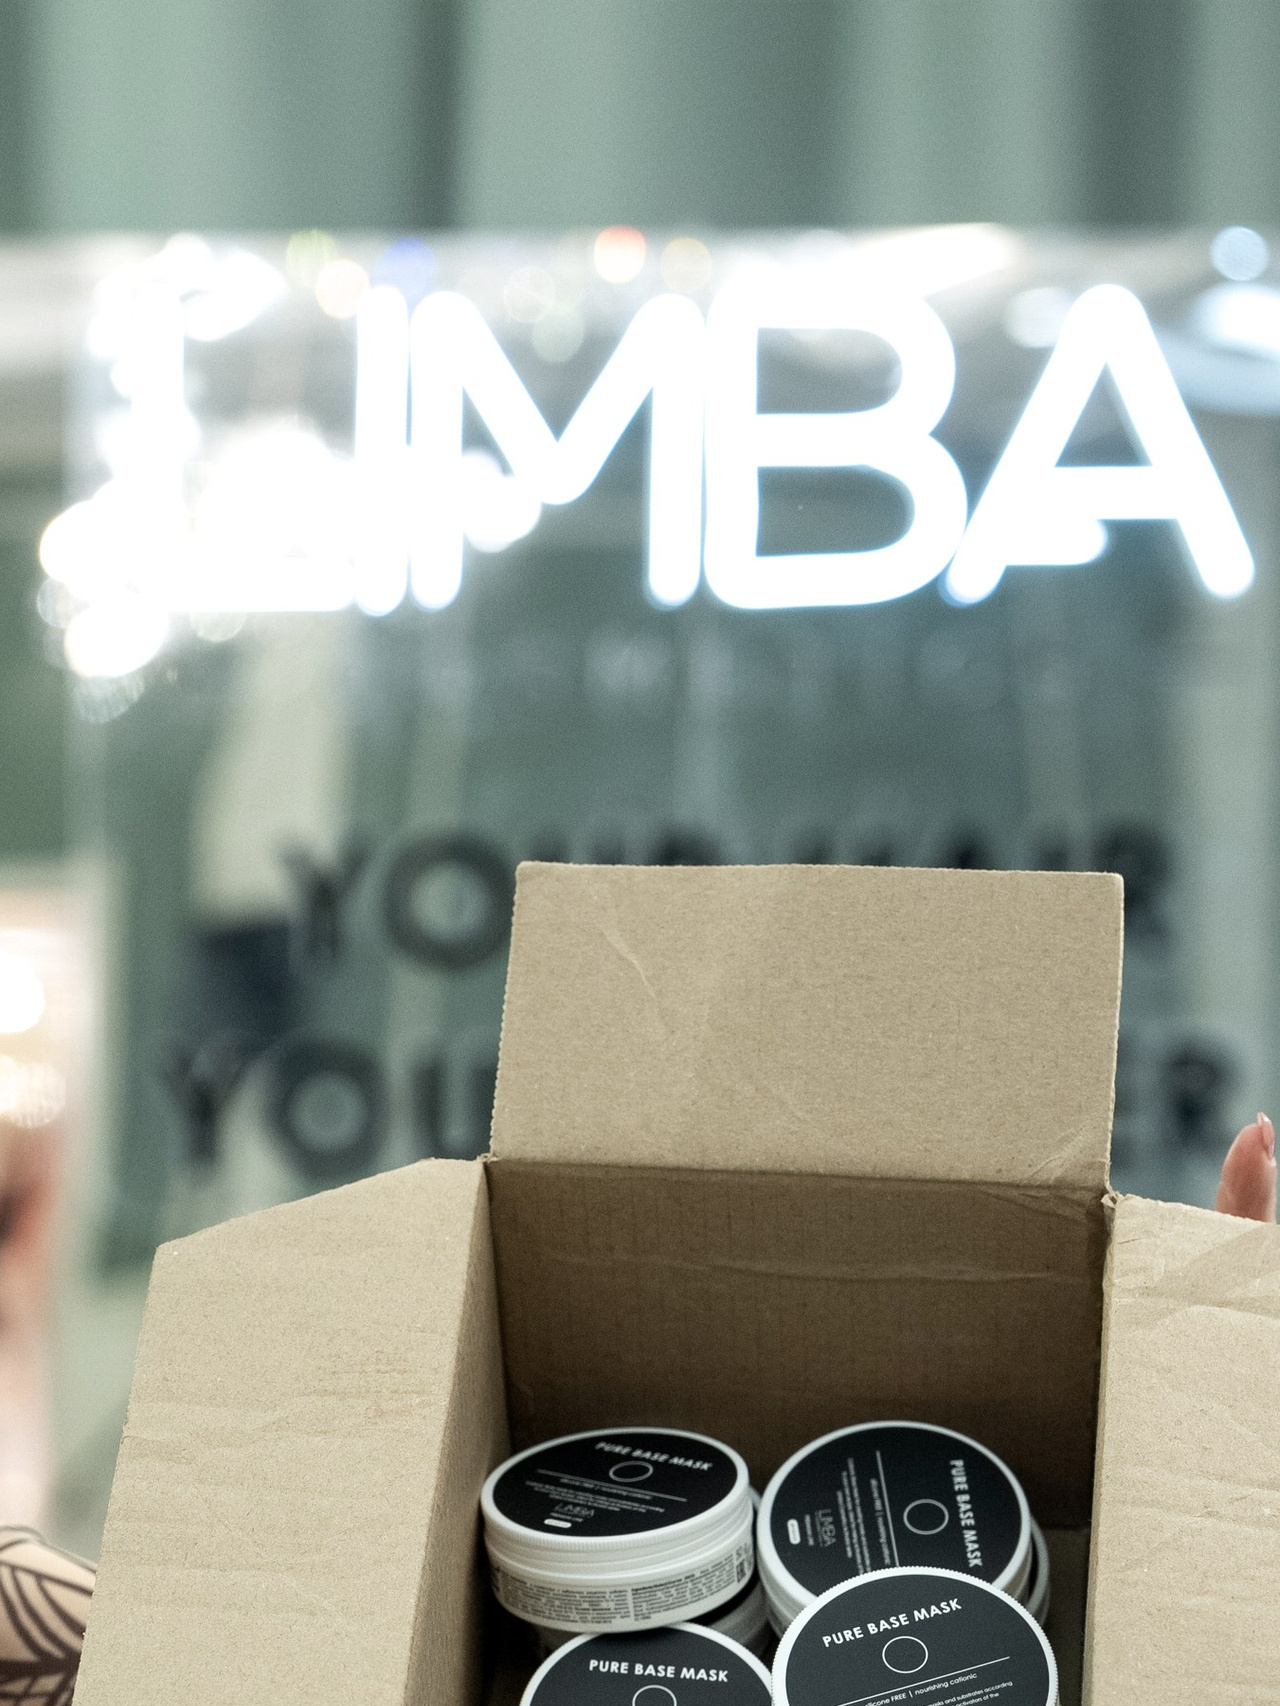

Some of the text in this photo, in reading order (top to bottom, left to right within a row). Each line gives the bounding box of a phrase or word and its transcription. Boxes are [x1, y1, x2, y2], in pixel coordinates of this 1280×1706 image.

[595, 1441, 713, 1471] PURE BASE MASK
[949, 1459, 983, 1568] PURE BASE MASK
[822, 1598, 961, 1647] PURE BASE MASK
[588, 1659, 728, 1682] PURE BASE MASK
[890, 1692, 906, 1701] FREE
[914, 1681, 948, 1695] nourishing
[949, 1673, 977, 1685] cationic
